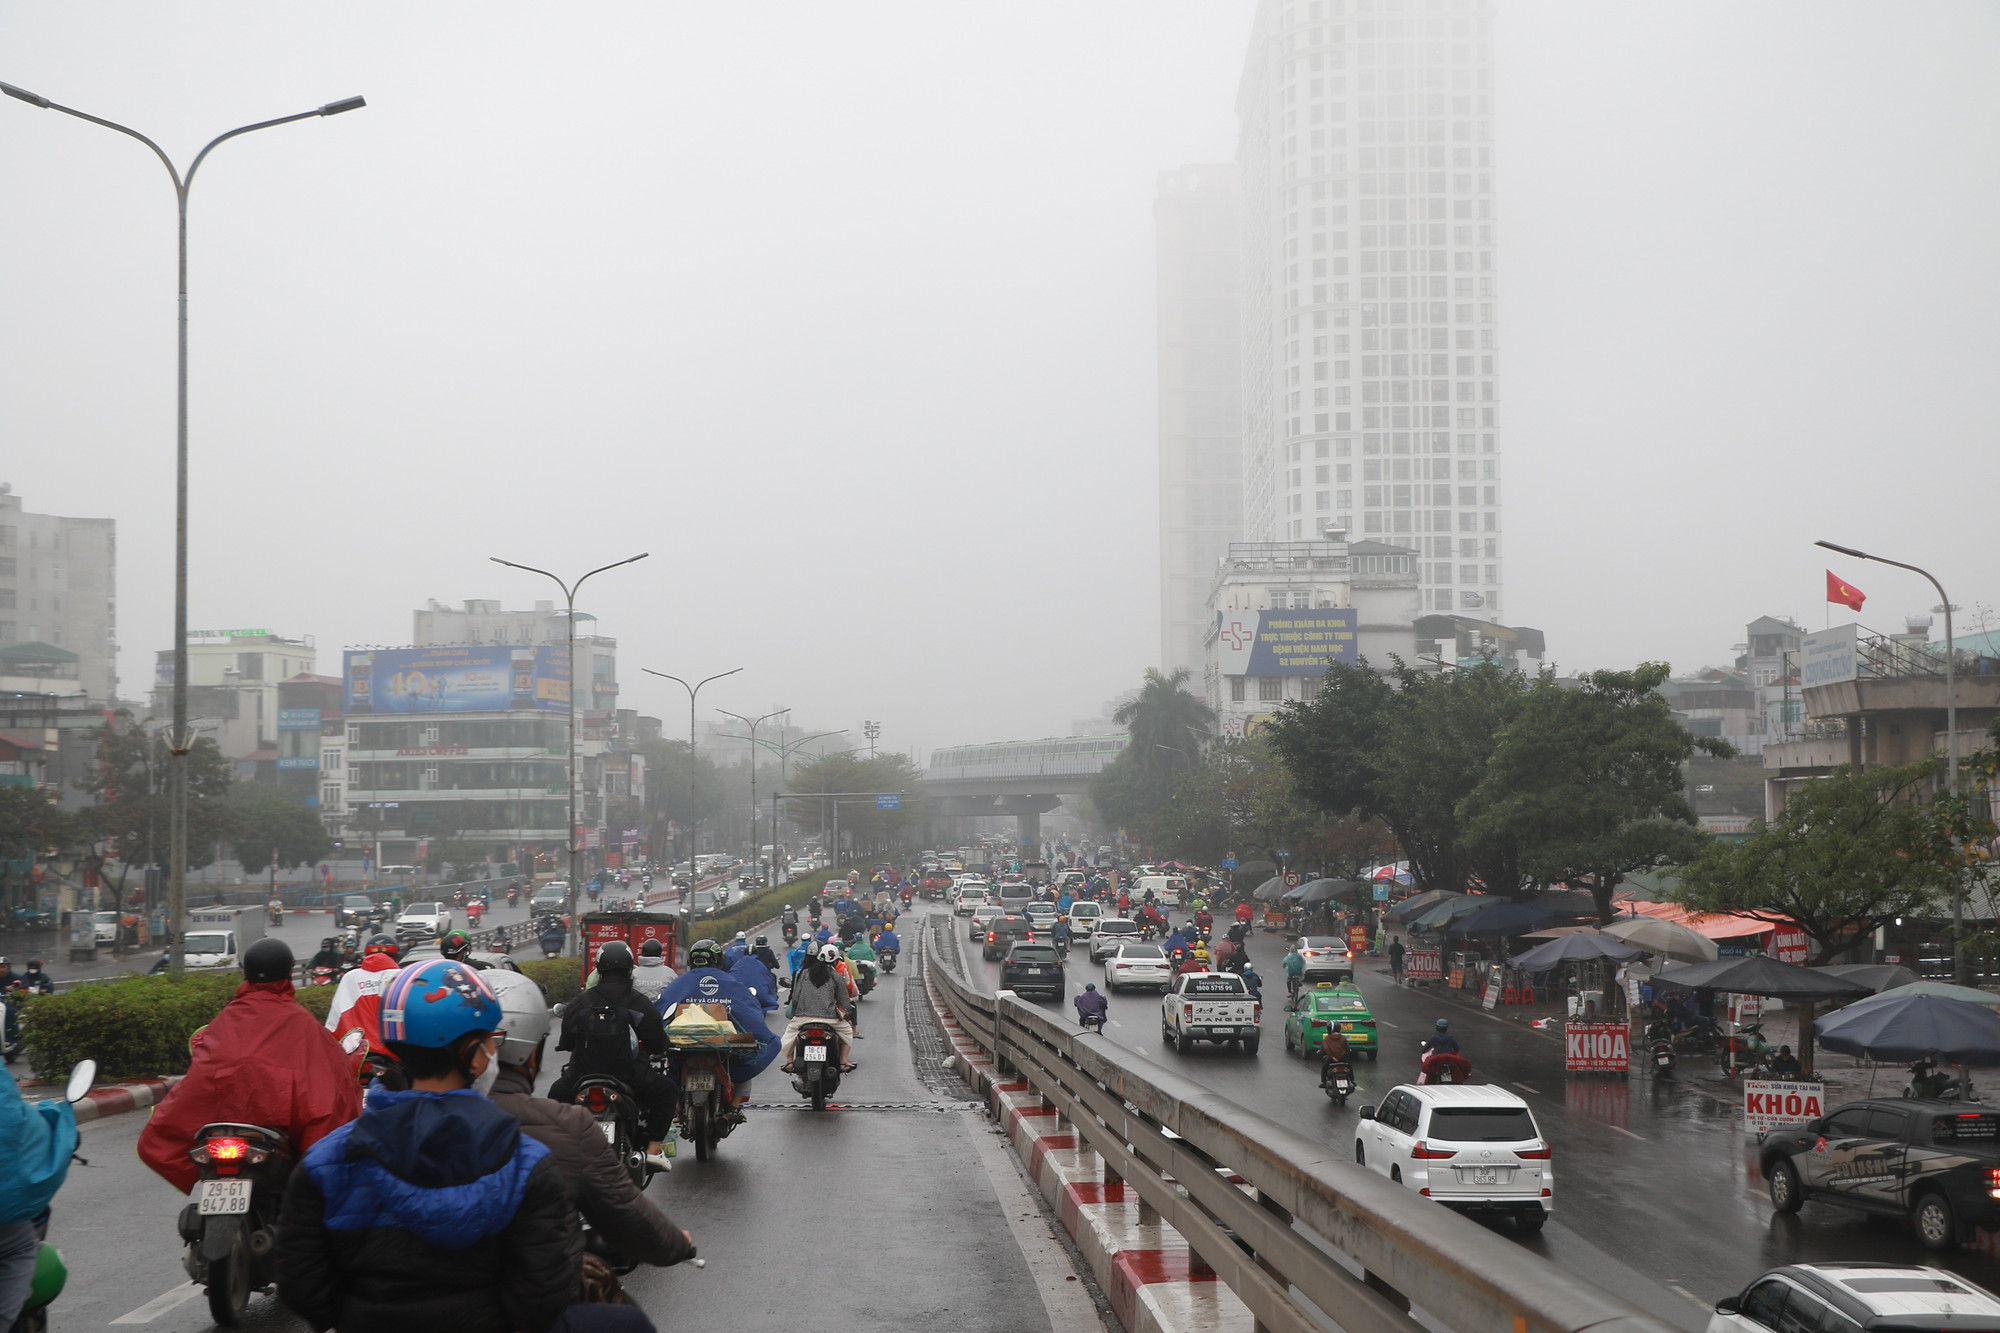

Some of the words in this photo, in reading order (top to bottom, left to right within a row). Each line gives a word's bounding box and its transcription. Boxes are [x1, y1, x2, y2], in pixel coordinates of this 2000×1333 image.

[1324, 632, 1333, 640] TY
[1567, 1030, 1628, 1059] KHÓA
[1747, 1091, 1822, 1117] KHÓA
[1834, 1159, 1888, 1177] TOKUSHI
[208, 1182, 244, 1197] 29-G1
[202, 1197, 246, 1212] 947.88
